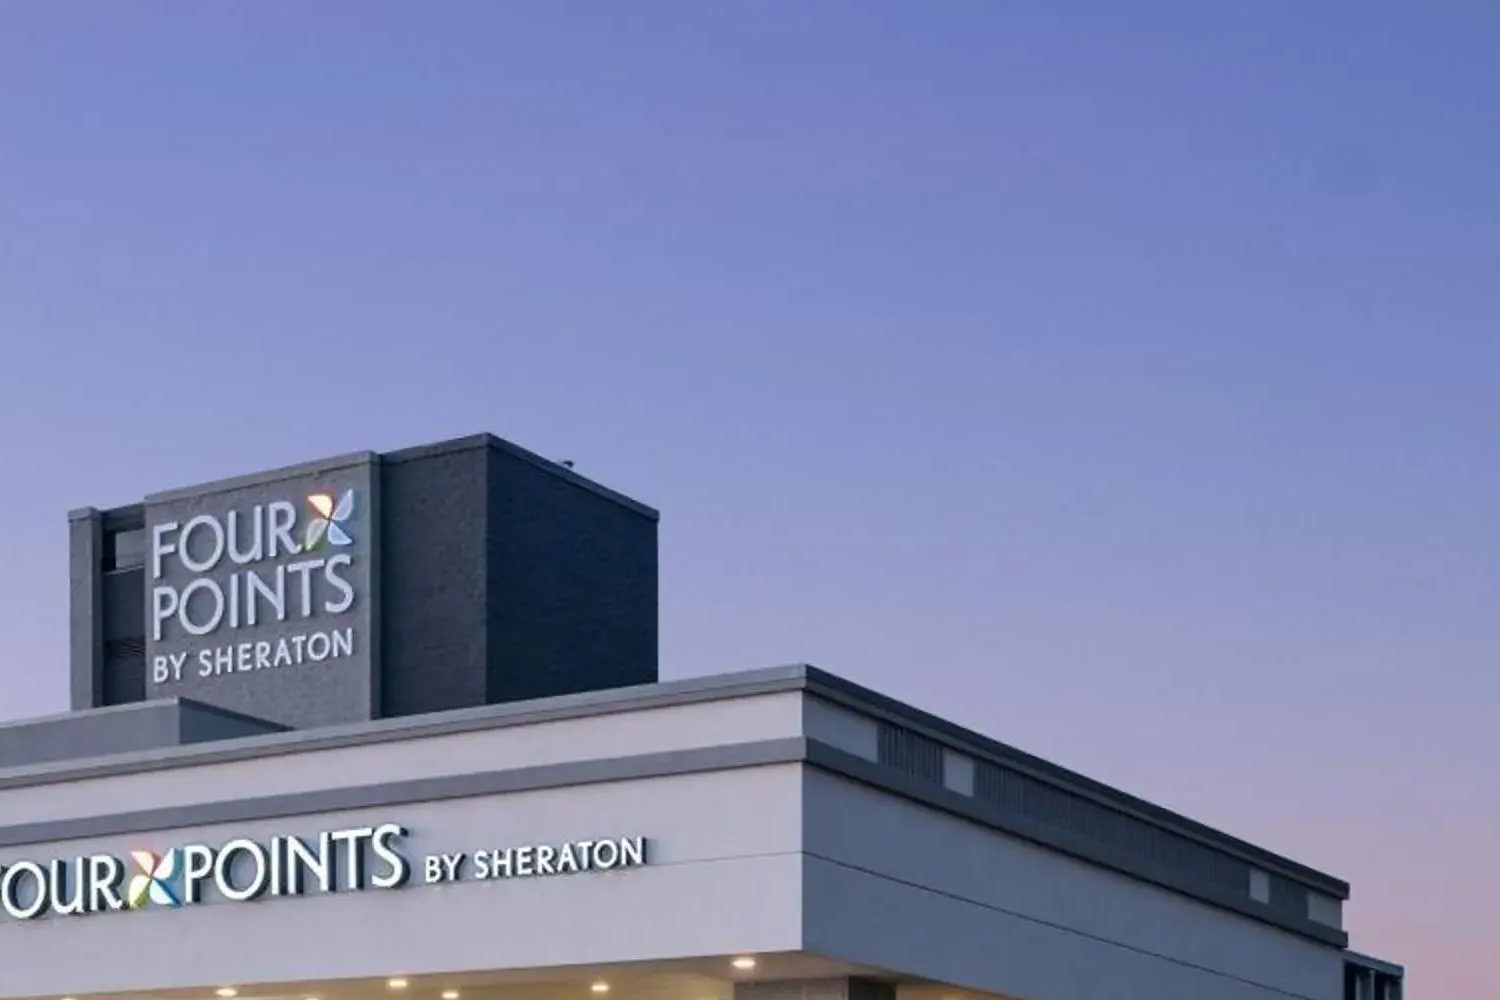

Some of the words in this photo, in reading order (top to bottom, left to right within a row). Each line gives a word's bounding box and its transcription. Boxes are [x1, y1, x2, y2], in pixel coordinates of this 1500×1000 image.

[153, 500, 302, 579] FOUR
[153, 553, 354, 641] POINTS
[153, 652, 187, 683] BY
[198, 627, 353, 677] SHERATON
[184, 823, 405, 903] POINTS
[425, 853, 464, 883] BY
[474, 836, 644, 879] SHERATON
